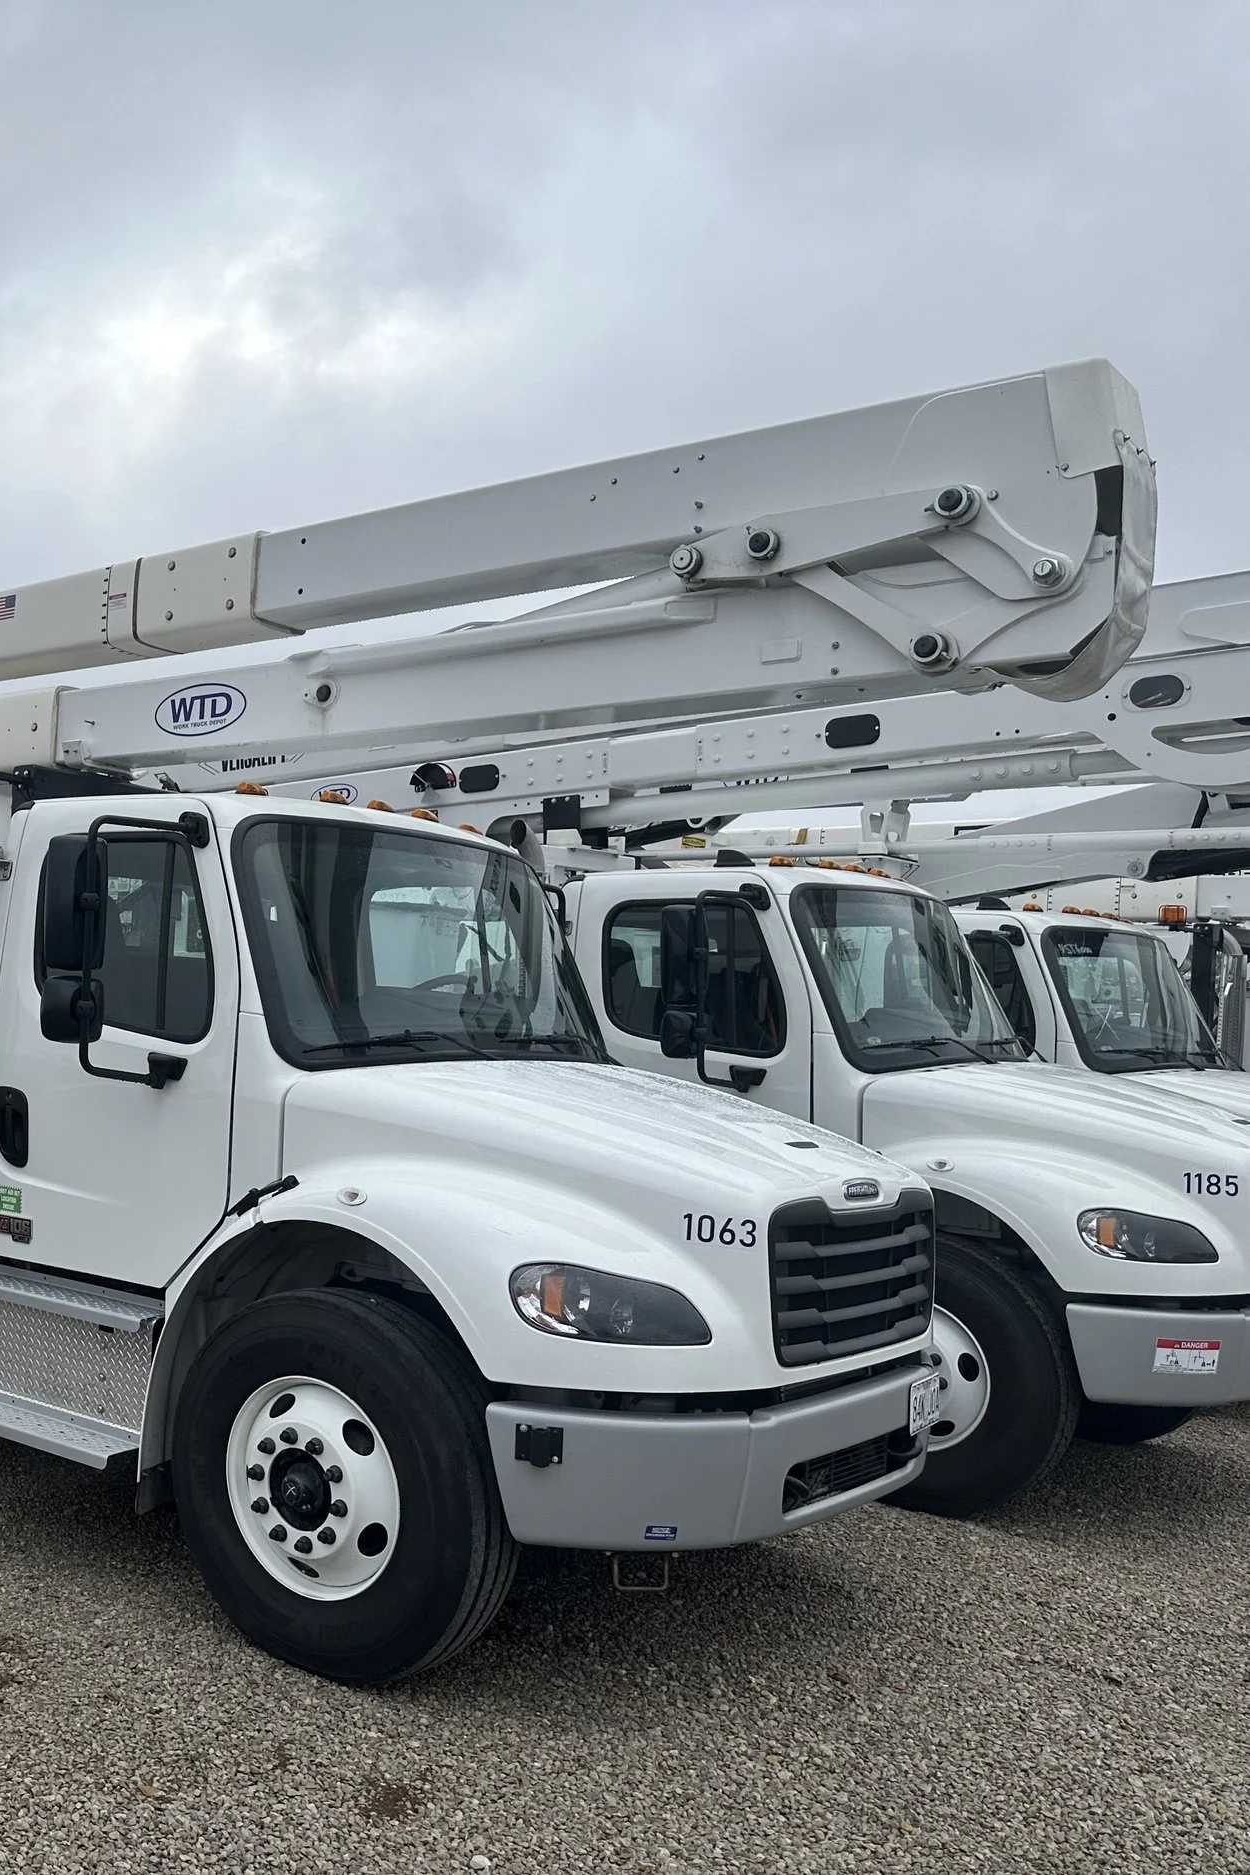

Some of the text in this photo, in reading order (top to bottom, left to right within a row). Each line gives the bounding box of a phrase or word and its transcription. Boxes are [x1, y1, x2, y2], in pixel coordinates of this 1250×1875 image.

[170, 692, 233, 723] WTD
[173, 718, 227, 730] WORK TRUCK DEPOT
[1183, 1172, 1239, 1197] 1185
[683, 1213, 757, 1248] 1063
[1181, 1341, 1209, 1349] DANGER
